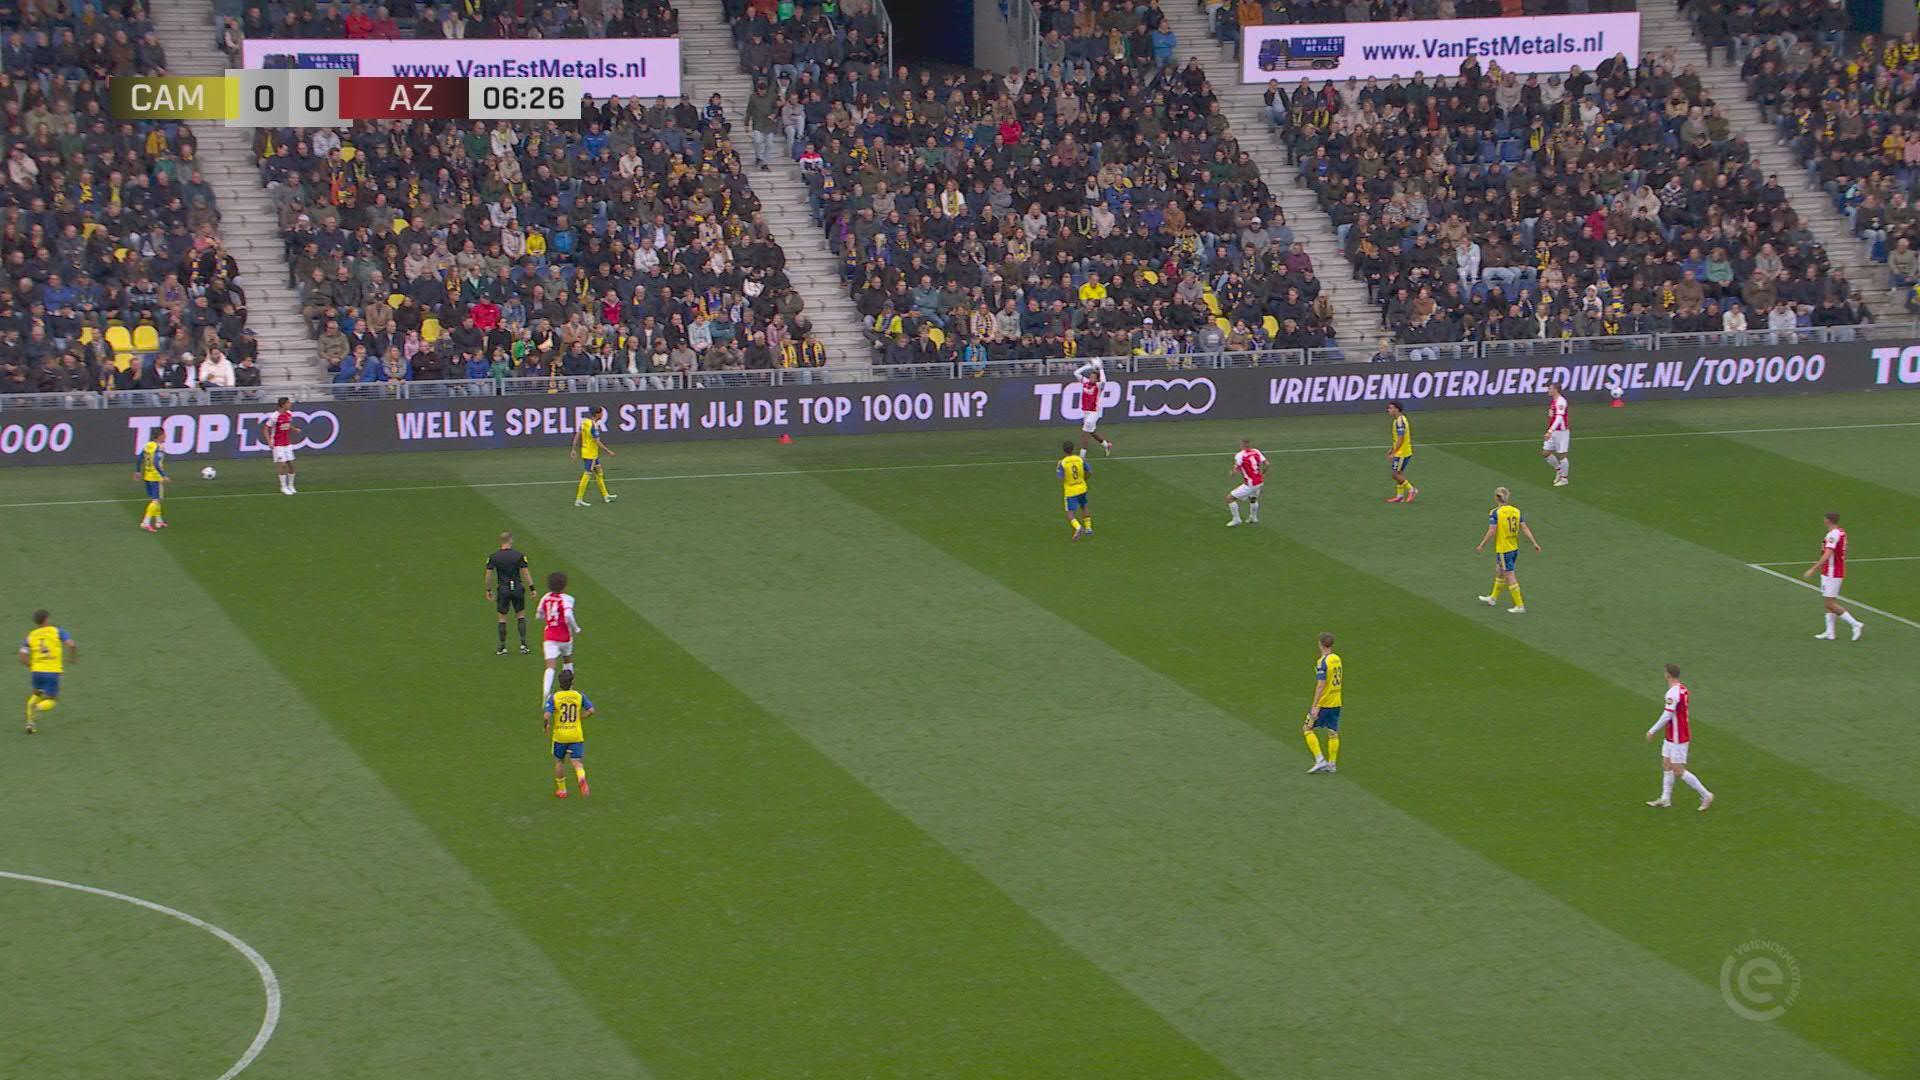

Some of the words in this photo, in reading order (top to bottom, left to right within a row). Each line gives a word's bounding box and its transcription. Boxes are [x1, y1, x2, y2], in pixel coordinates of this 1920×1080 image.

[1363, 31, 1604, 60] www.VanEstMetals.nl
[1269, 354, 1825, 404] VRIENDENLOTERIJEREDIVISIE.NL/TOP1000
[396, 409, 494, 439] WELKE
[619, 402, 691, 432] STEM
[700, 400, 744, 428] JIJ
[754, 399, 788, 426] DE
[798, 396, 851, 424] TOP
[861, 393, 934, 422] 1000
[943, 390, 989, 418] IN?
[1034, 380, 1122, 420] TOP
[128, 413, 231, 456] TOP
[1507, 516, 1518, 534] 13
[560, 703, 577, 723] 30
